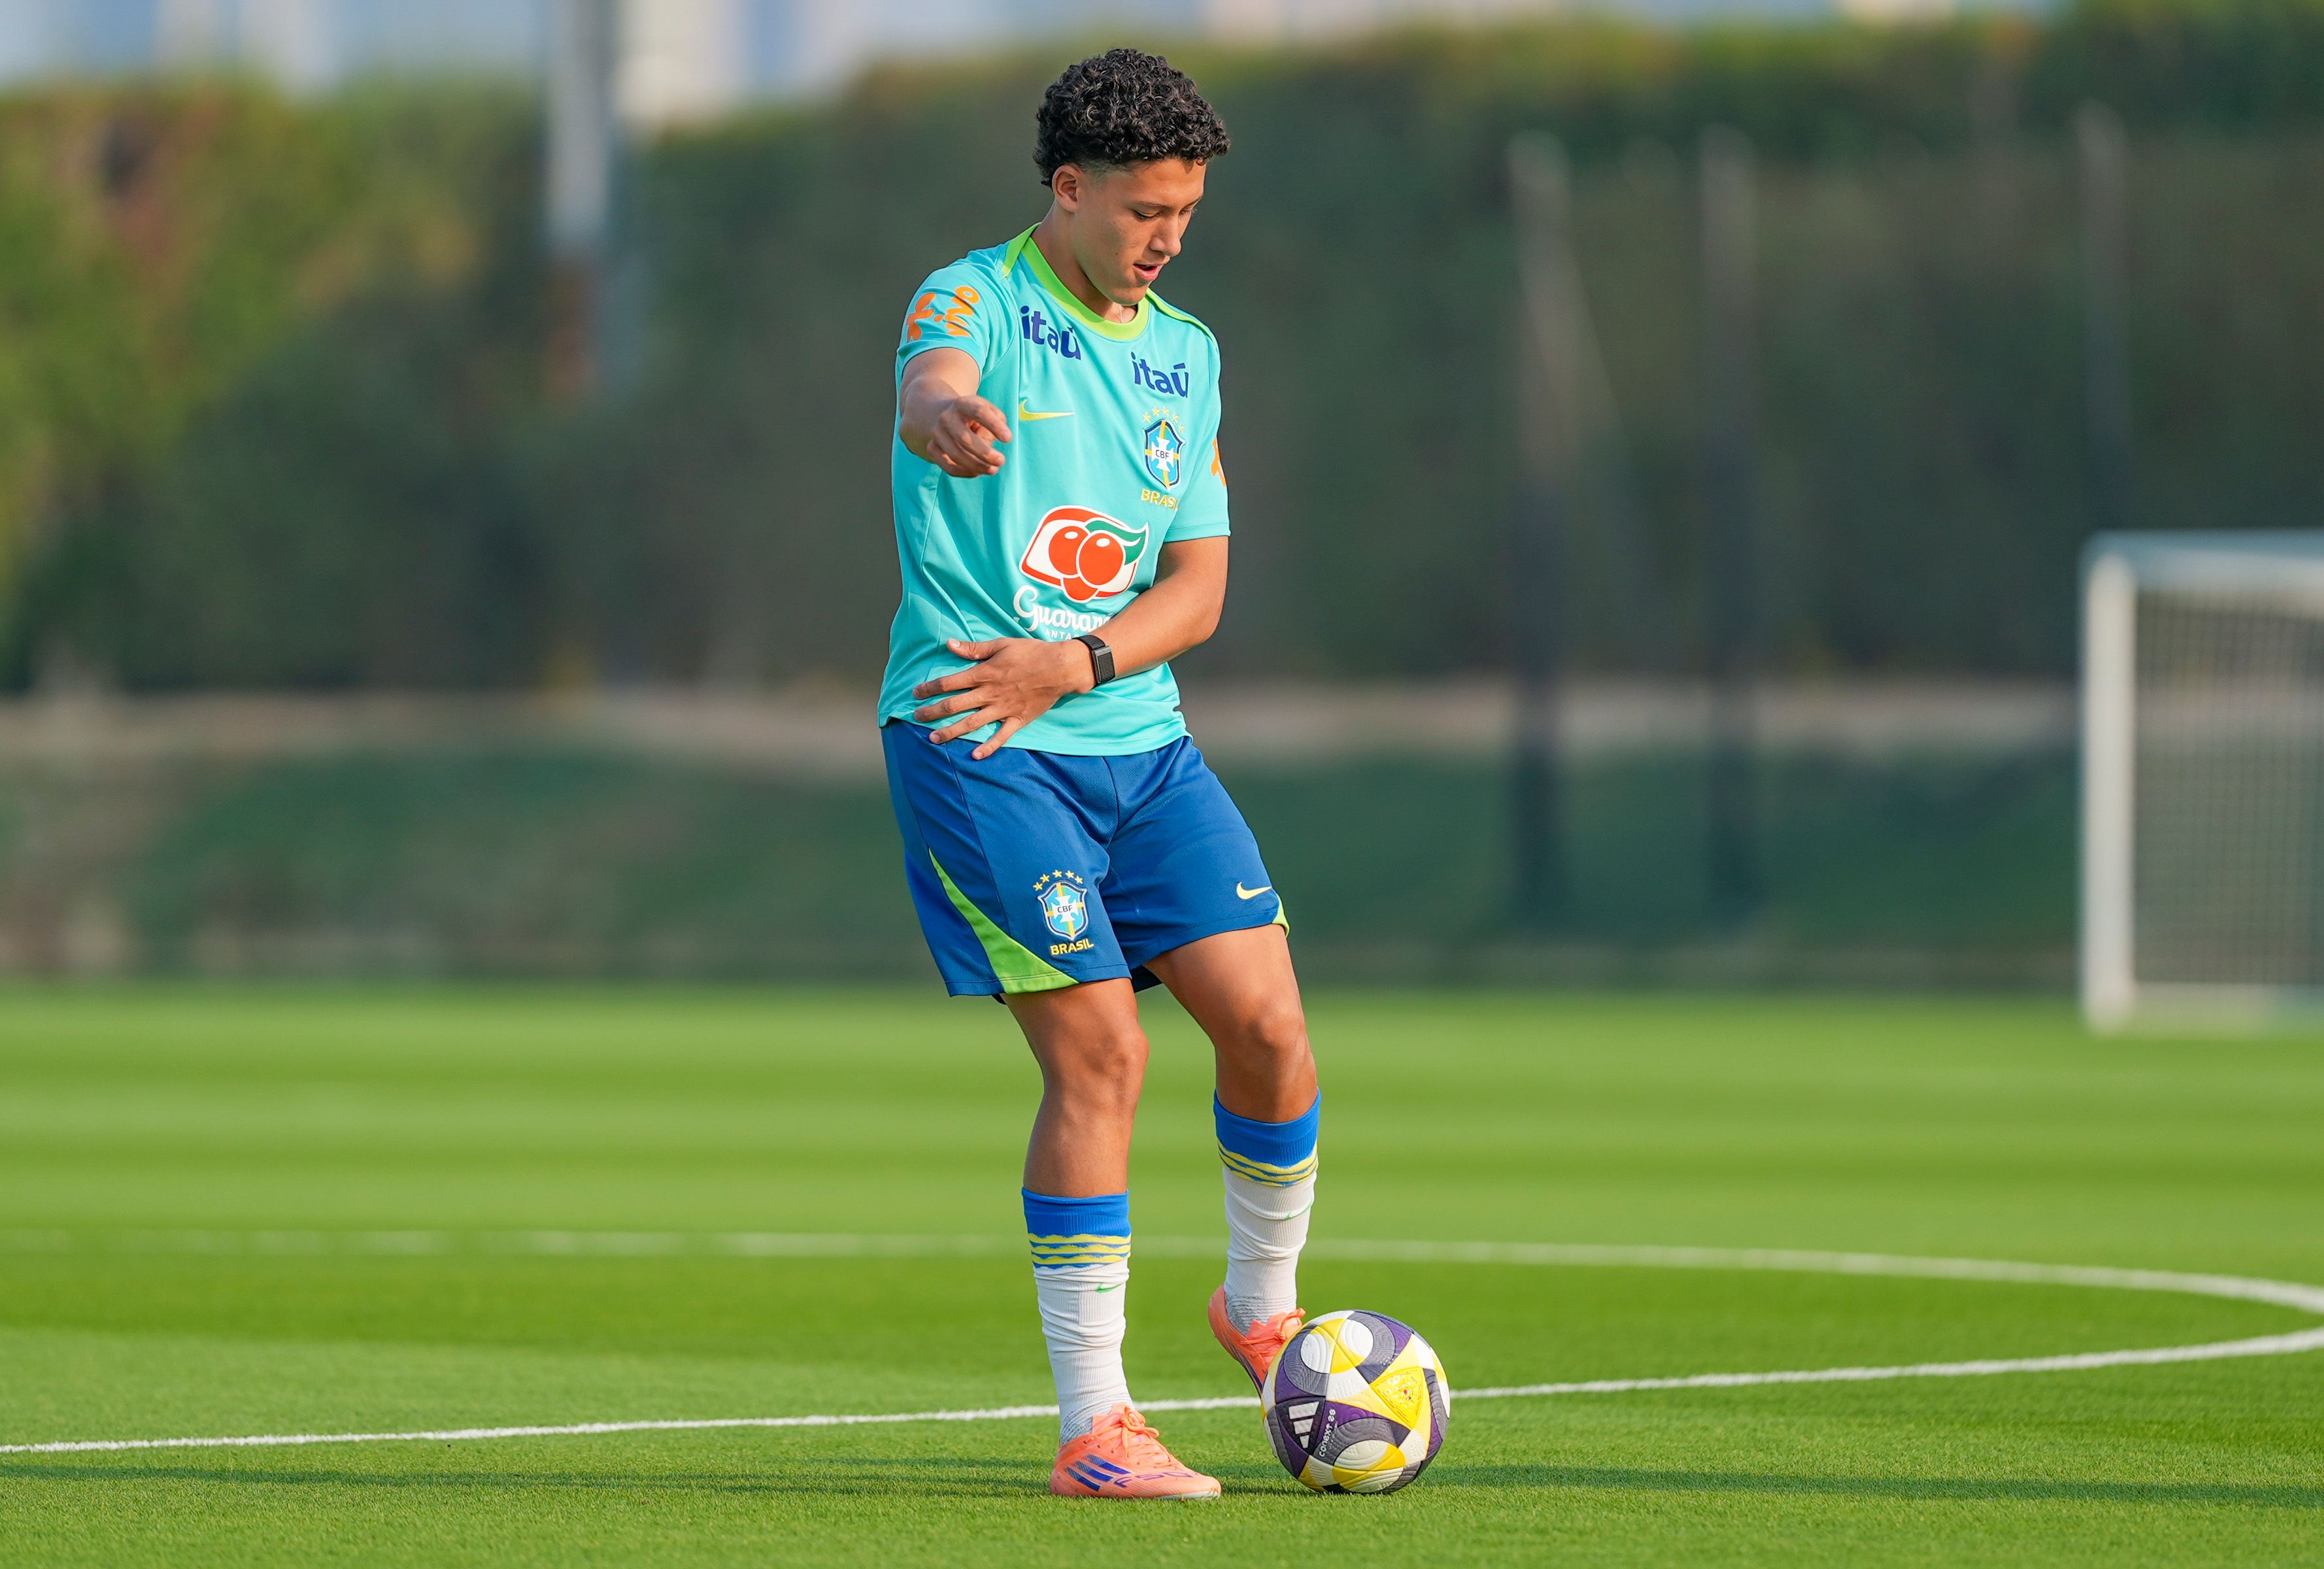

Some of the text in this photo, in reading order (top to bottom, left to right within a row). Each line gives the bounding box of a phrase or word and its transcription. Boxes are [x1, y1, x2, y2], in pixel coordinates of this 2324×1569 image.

[1020, 305, 1082, 360] itaú
[1131, 351, 1189, 398] itaú
[1155, 449, 1170, 460] CBF
[1141, 488, 1179, 511] BRASI
[1057, 905, 1073, 913] CBF
[1050, 938, 1094, 956] BRASIL
